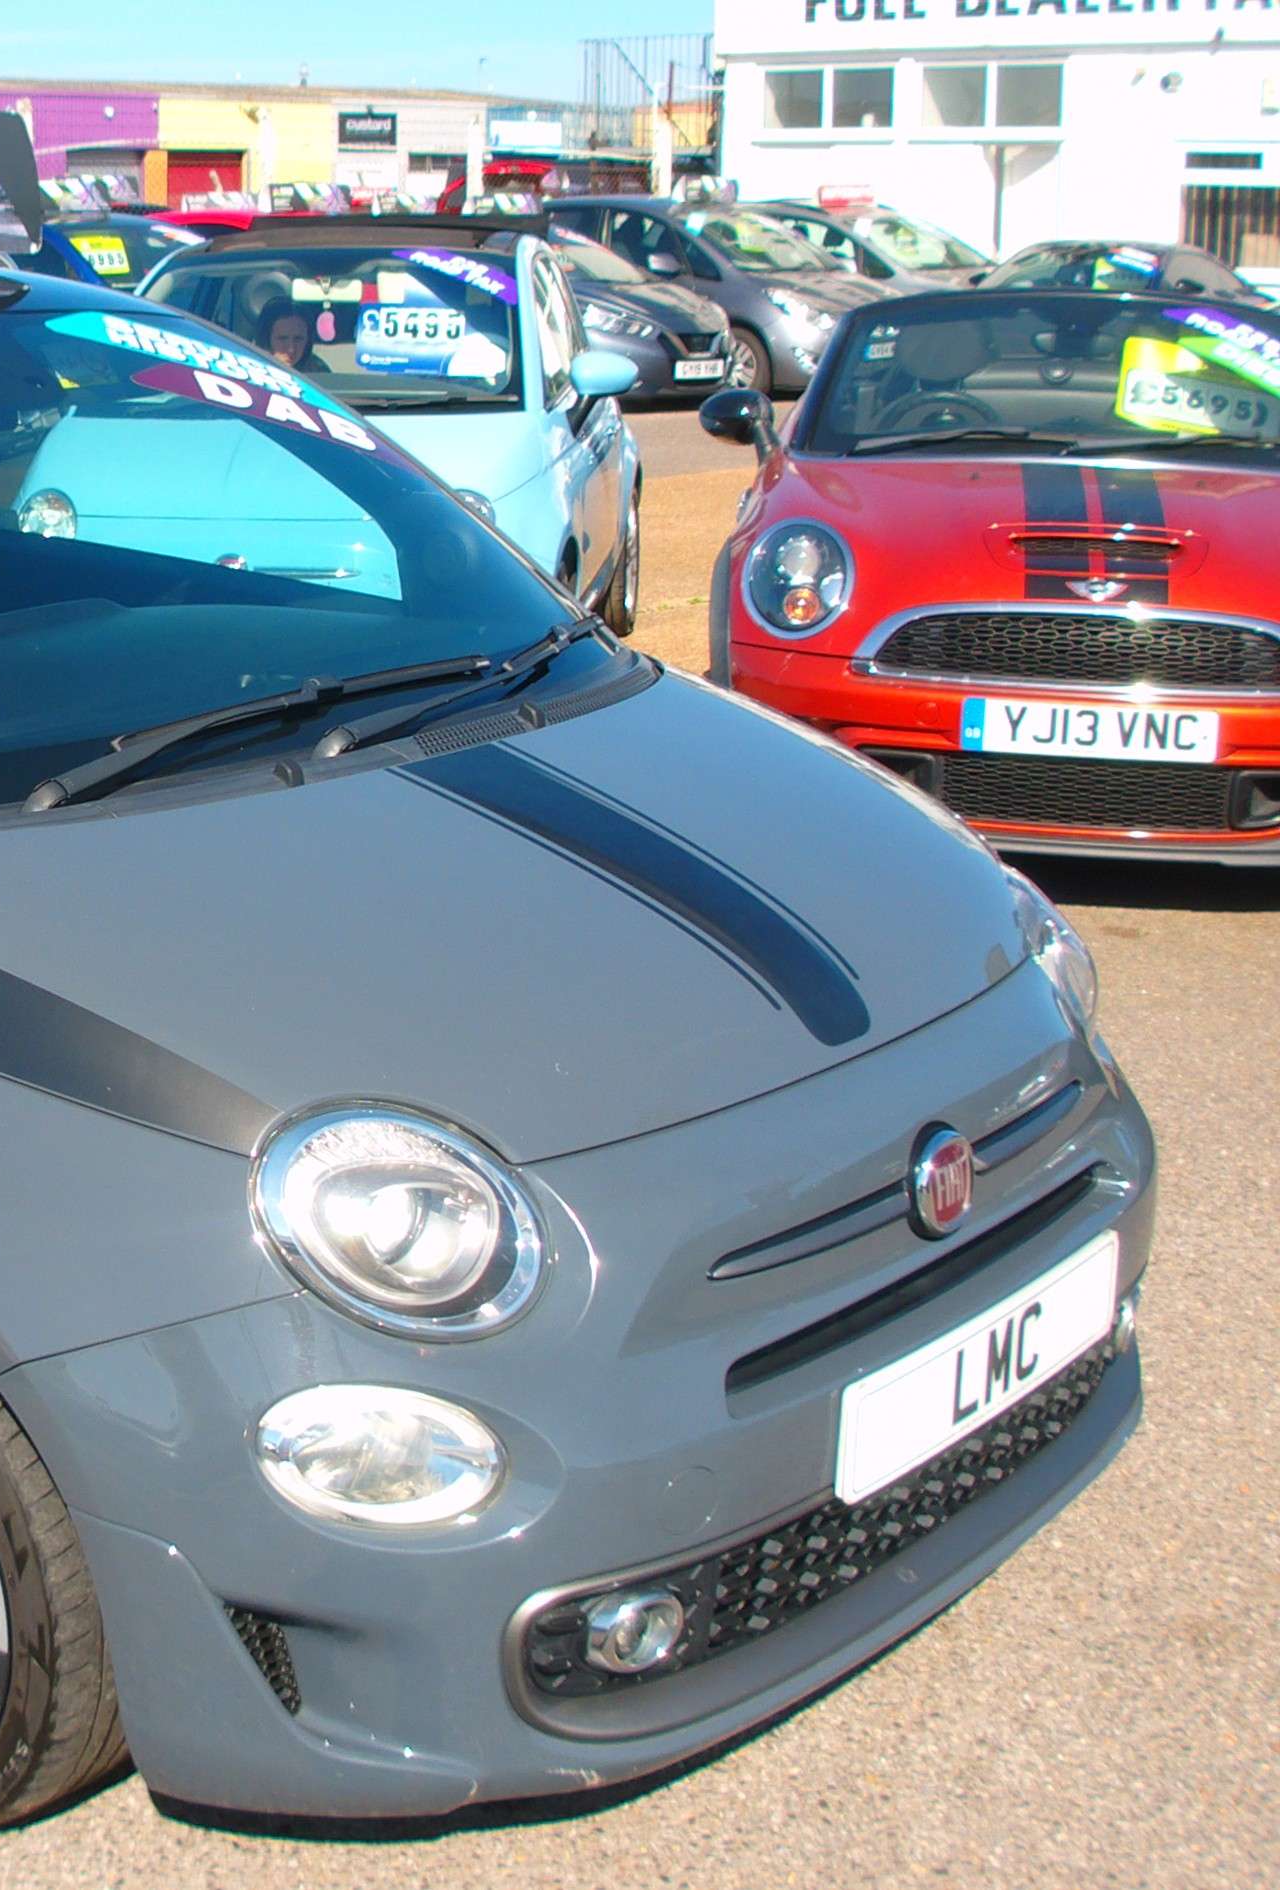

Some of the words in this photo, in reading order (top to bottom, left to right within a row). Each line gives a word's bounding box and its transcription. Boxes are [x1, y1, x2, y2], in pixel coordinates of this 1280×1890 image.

[194, 370, 376, 451] DAB
[1005, 705, 1099, 746] YJ13
[1117, 711, 1198, 750] VNC
[935, 1157, 970, 1210] FIAT
[953, 1302, 1042, 1426] LMC
